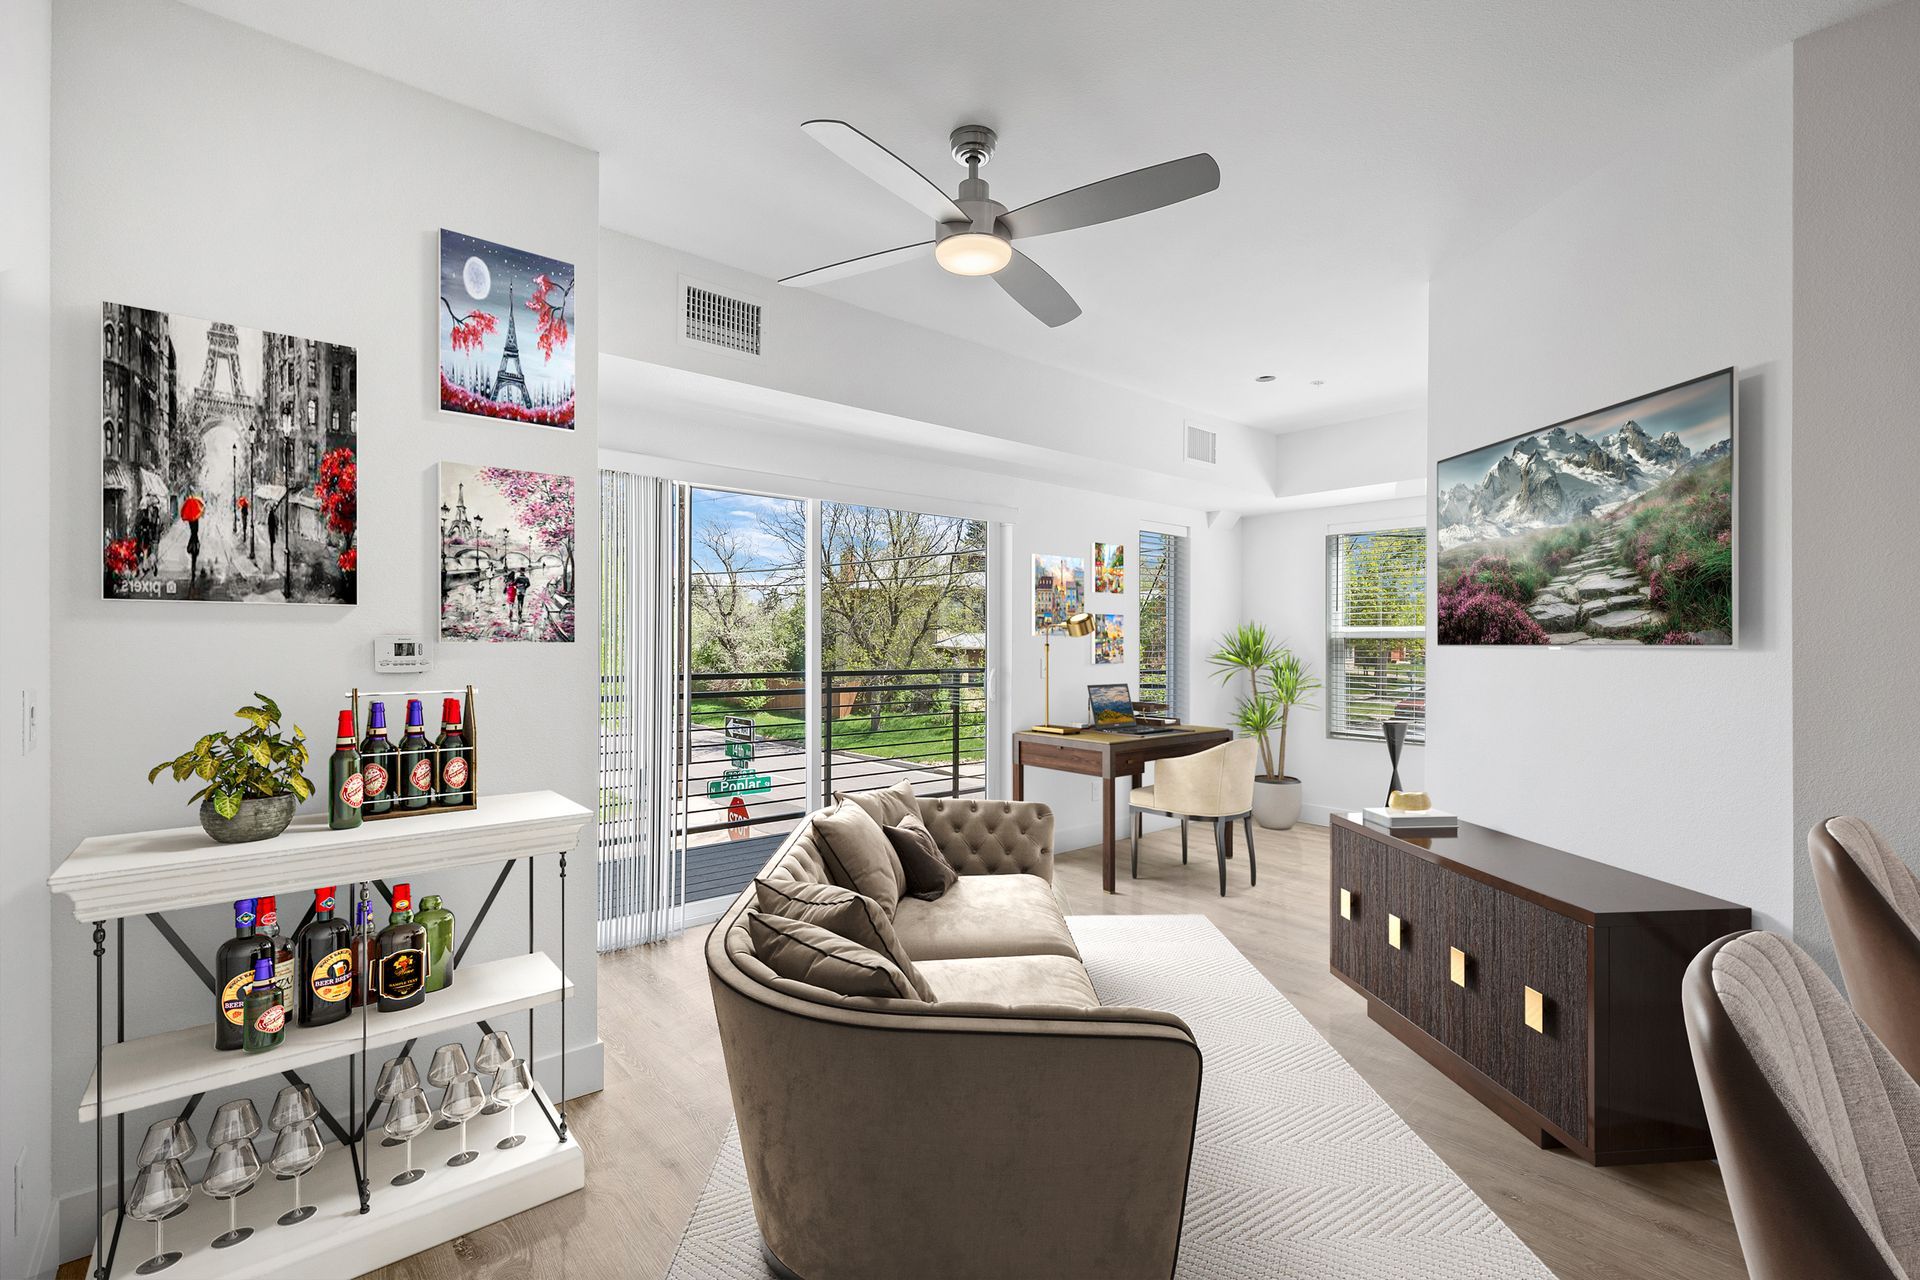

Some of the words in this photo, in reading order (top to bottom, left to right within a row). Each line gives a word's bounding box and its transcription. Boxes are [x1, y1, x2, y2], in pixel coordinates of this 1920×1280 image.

[720, 780, 761, 794] Poplar
[315, 979, 335, 987] BEER
[224, 1001, 244, 1009] BEER
